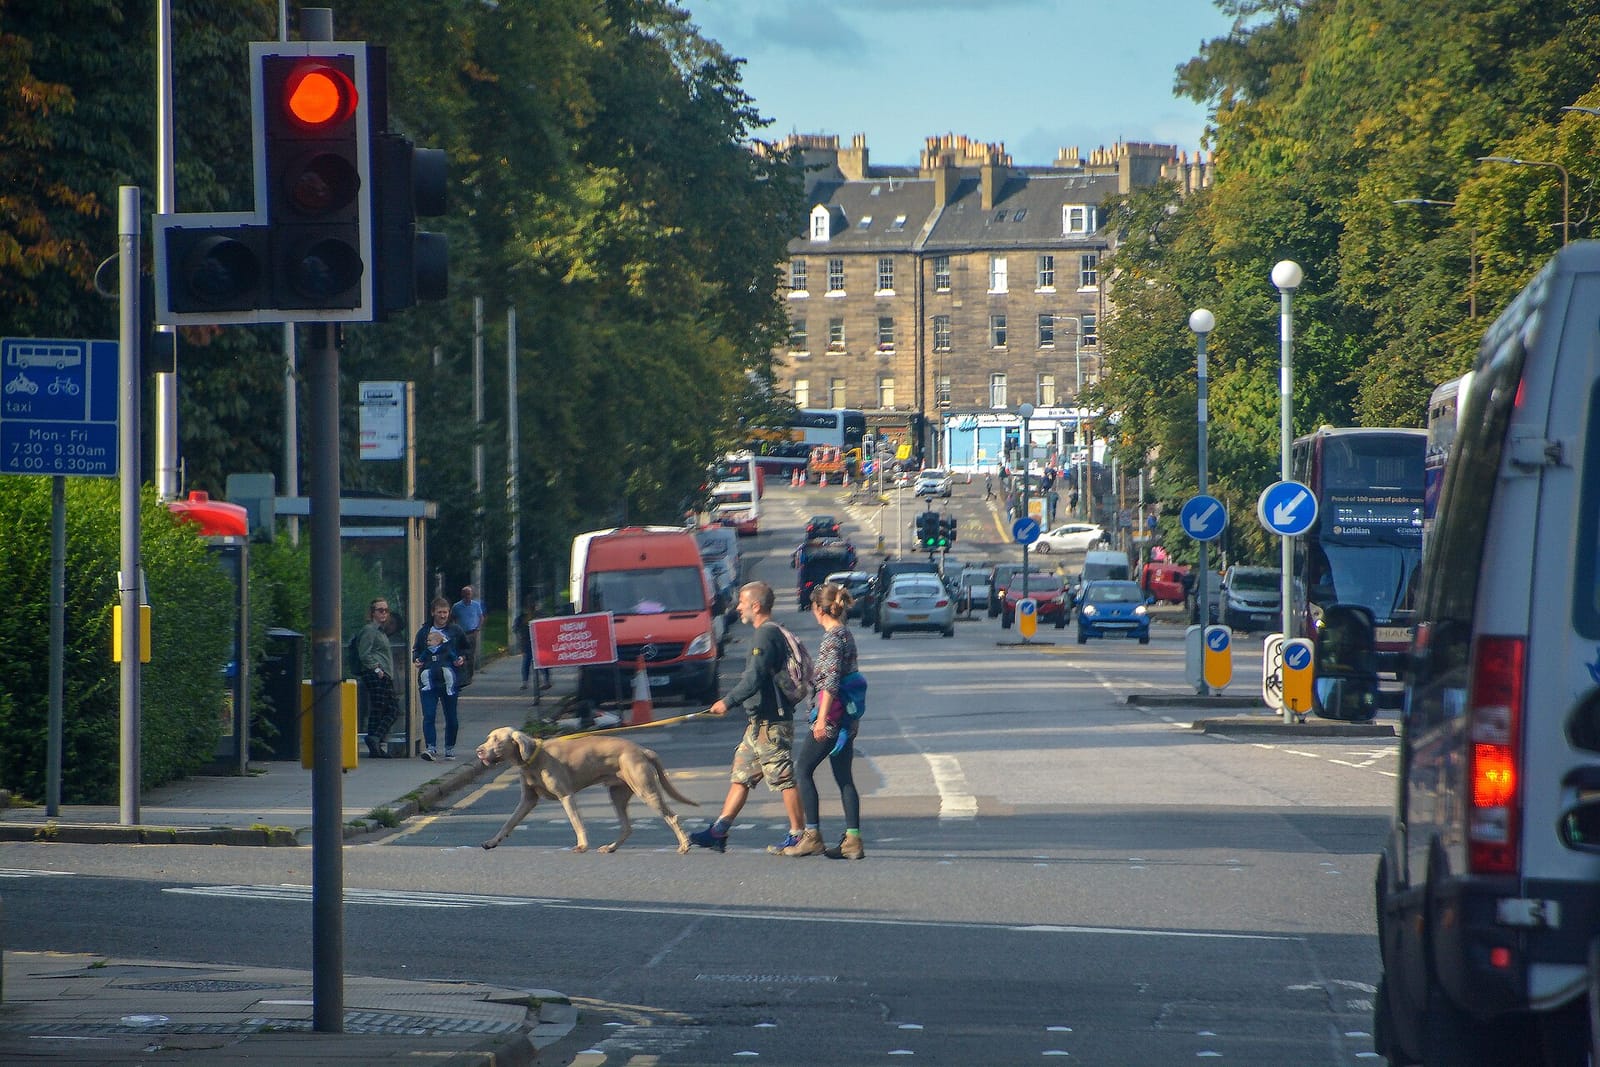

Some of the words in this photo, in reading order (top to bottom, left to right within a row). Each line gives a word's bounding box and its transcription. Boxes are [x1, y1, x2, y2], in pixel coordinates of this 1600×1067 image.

[6, 401, 32, 412] taxi
[29, 428, 58, 440] Mon
[71, 429, 88, 441] Fri
[11, 442, 42, 455] 7.30
[54, 443, 106, 456] 9.30am
[54, 458, 106, 471] 6.30pm
[1342, 527, 1370, 535] Lothian
[560, 621, 587, 632] NEW
[557, 631, 592, 642] ROAD
[558, 649, 597, 660] AHEAD
